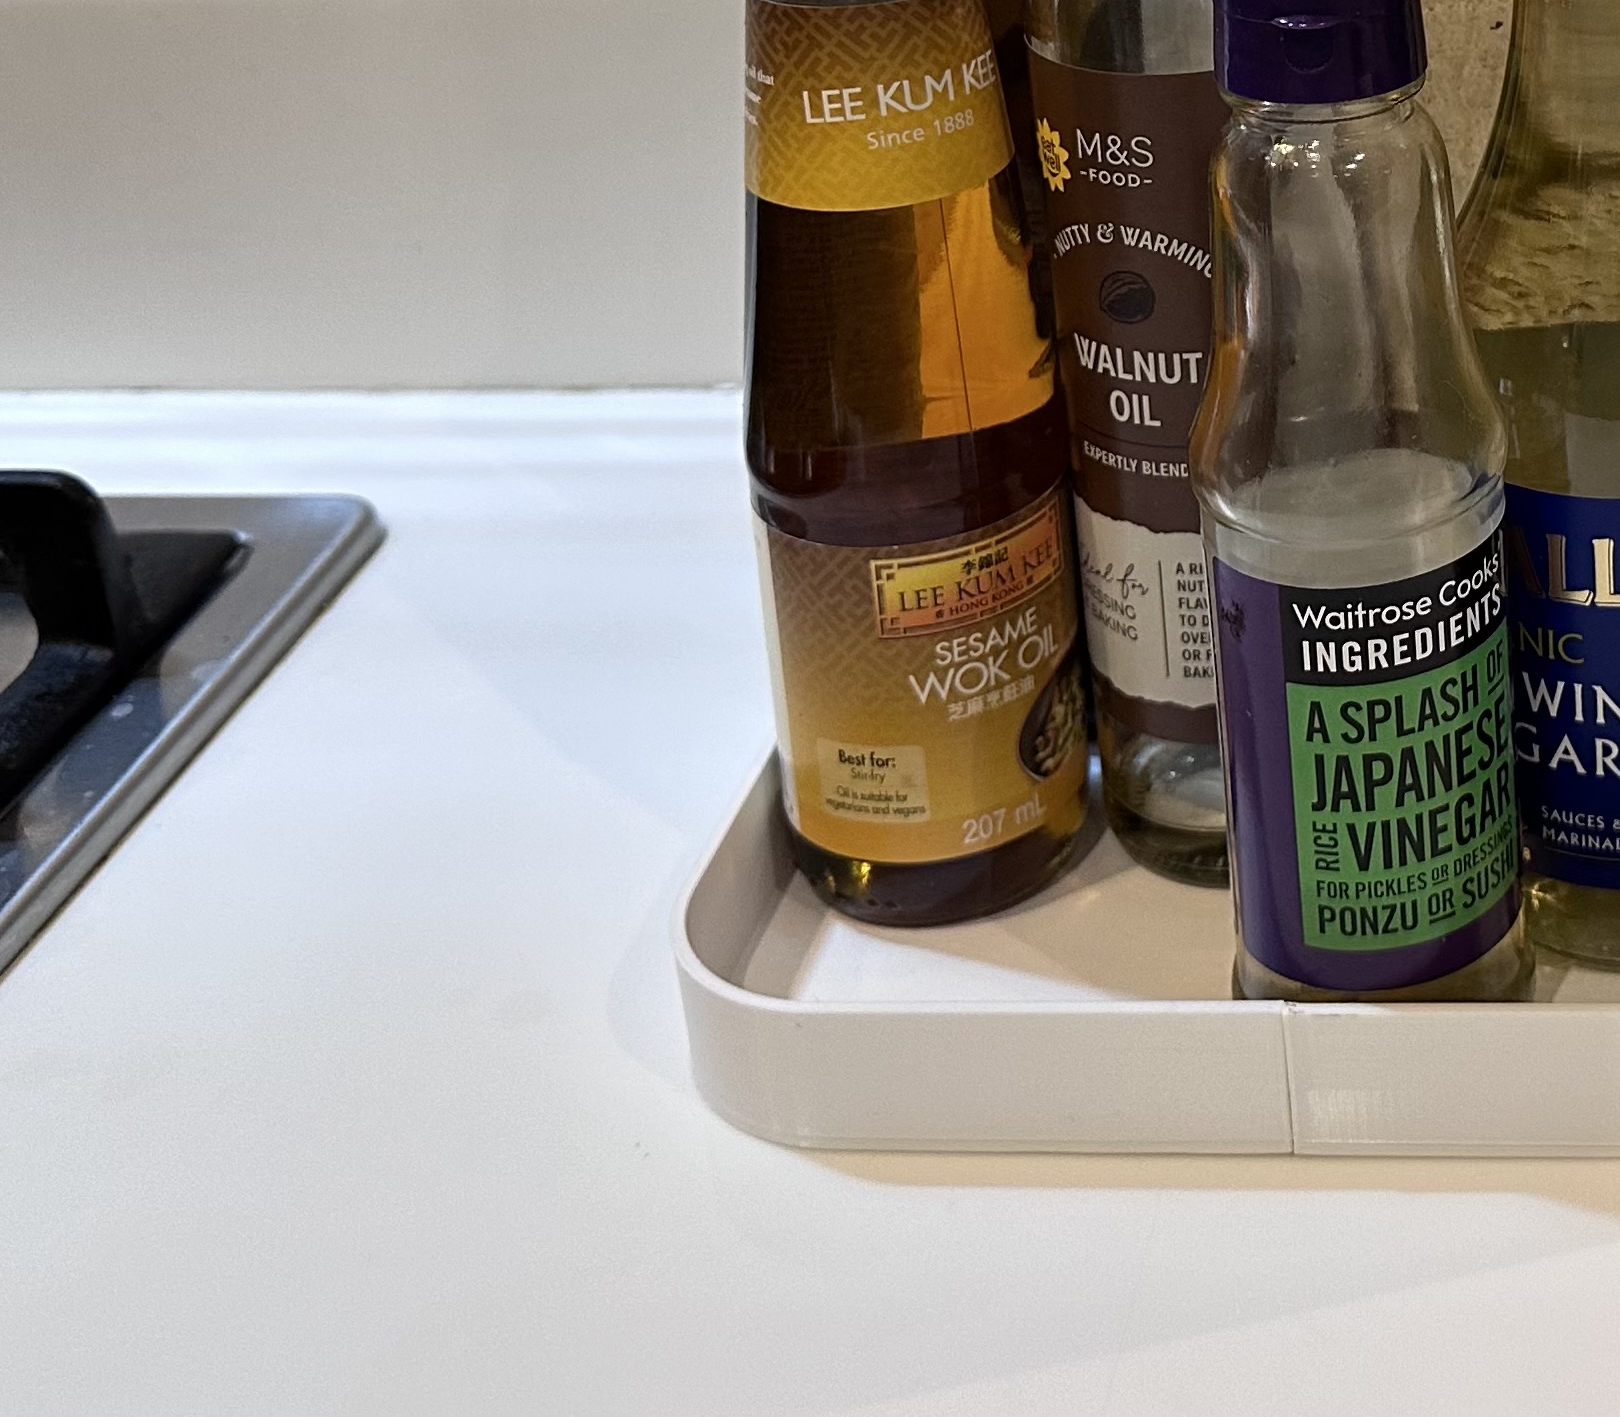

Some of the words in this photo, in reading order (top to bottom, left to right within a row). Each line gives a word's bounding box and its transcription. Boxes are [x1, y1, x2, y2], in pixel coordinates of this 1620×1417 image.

[802, 87, 866, 124] LEE
[876, 69, 955, 117] KUM
[962, 49, 996, 96] KEE
[867, 127, 925, 150] Since
[933, 109, 975, 137] 1888
[1076, 128, 1154, 168] M&S
[1054, 223, 1091, 257] NUTTY
[1097, 222, 1114, 243] &
[1074, 332, 1203, 385] WALNUT
[1109, 389, 1162, 427] OIL
[1084, 440, 1138, 474] EXPERTLY
[898, 585, 945, 612] LEE
[954, 566, 1016, 602] KUM
[1021, 541, 1052, 575] KEE
[1116, 563, 1149, 600] for
[1176, 563, 1185, 575] A
[1177, 580, 1206, 593] NUT
[949, 596, 989, 616] HONG
[991, 583, 1025, 603] KONG
[1292, 595, 1432, 630] Waitrose
[1438, 552, 1500, 607] Cooks
[935, 606, 1037, 666] SESAME
[1179, 614, 1197, 627] TO
[1302, 582, 1501, 673] INGREDIENTS
[908, 649, 1011, 706] WOK
[1017, 623, 1059, 669] OIL
[1182, 649, 1201, 661] OR
[1305, 700, 1331, 744] A
[1340, 666, 1480, 744] SPLASH
[1486, 638, 1504, 683] OF
[838, 749, 866, 767] Best
[870, 751, 896, 769] for:
[1311, 689, 1509, 813] JAPANESE
[962, 807, 1007, 845] 207
[1346, 760, 1512, 873] VINEGAR
[1541, 805, 1605, 829] SAUCES
[1312, 821, 1341, 872] RICE
[1316, 880, 1350, 900] FOR
[1355, 871, 1427, 901] PICKLES
[1431, 862, 1450, 882] OR
[1317, 899, 1420, 938] PONZU
[1427, 887, 1456, 917] OR
[1462, 838, 1515, 910] SUSHI
